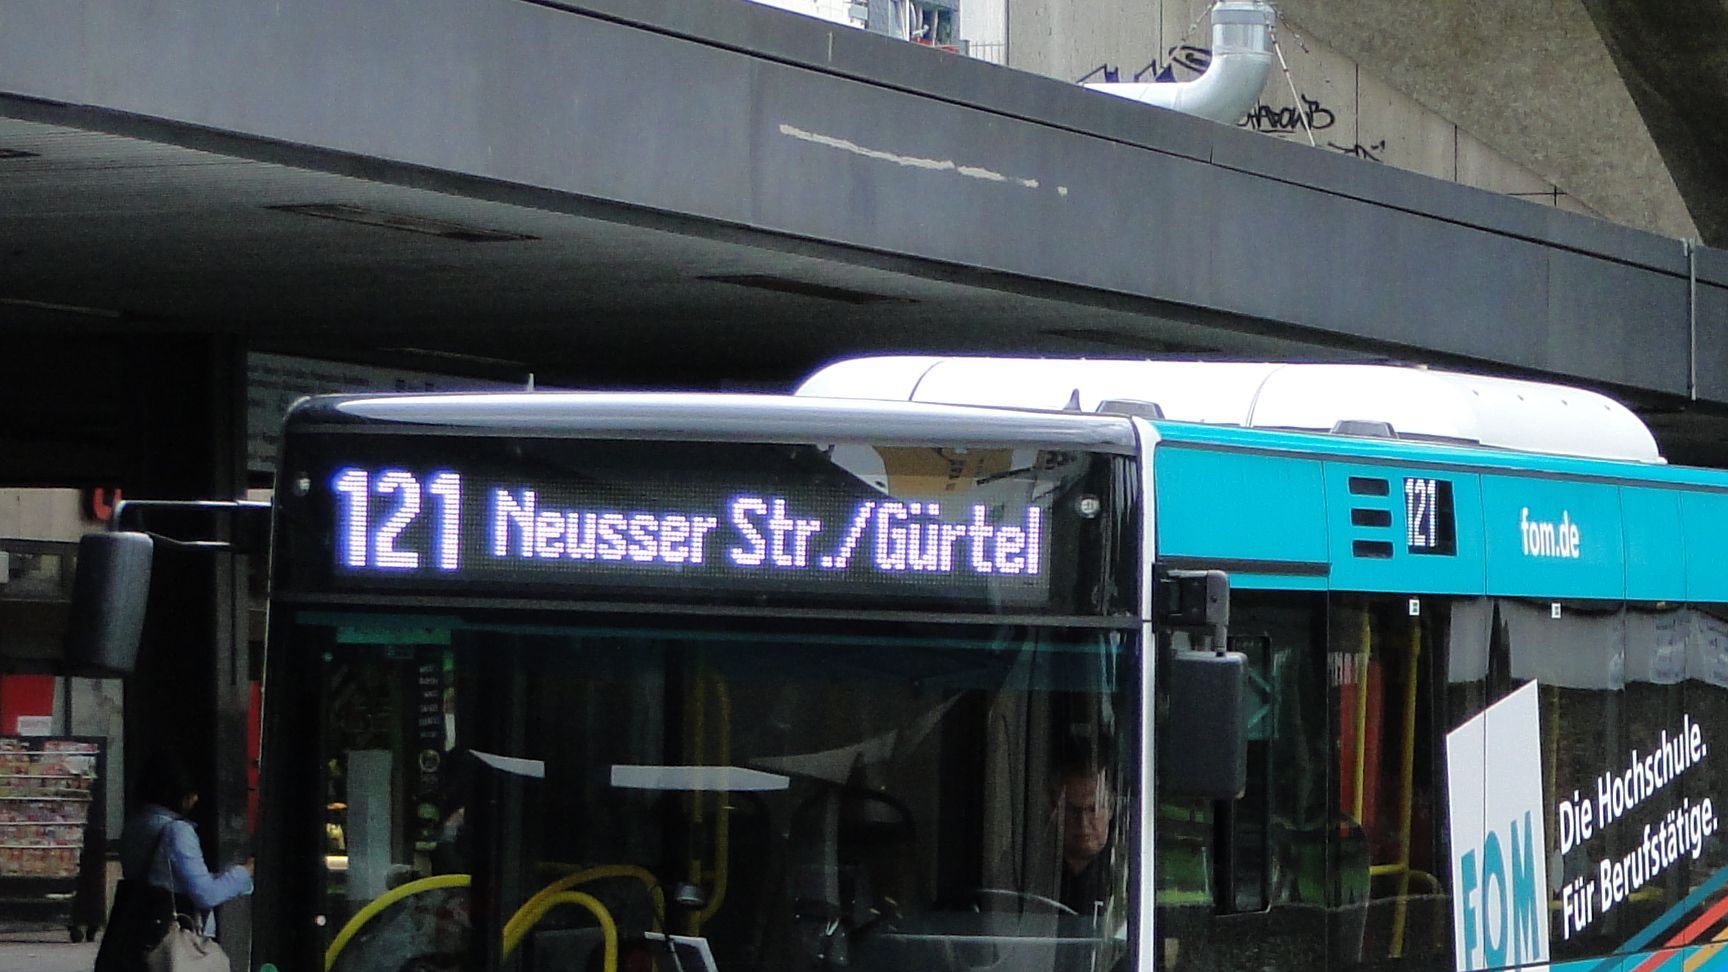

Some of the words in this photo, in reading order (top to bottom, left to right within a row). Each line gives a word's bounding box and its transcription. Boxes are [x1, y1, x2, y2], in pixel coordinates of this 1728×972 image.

[336, 469, 461, 570] 121
[494, 487, 718, 563] Neusser
[730, 497, 1040, 575] Str./Gürtel
[1404, 477, 1437, 548] 121
[1520, 506, 1581, 559] fom.de
[1559, 790, 1593, 855] Die
[1597, 713, 1708, 829] Hochschule.
[1562, 870, 1596, 941] Für
[1599, 796, 1719, 914] Berufstätige.
